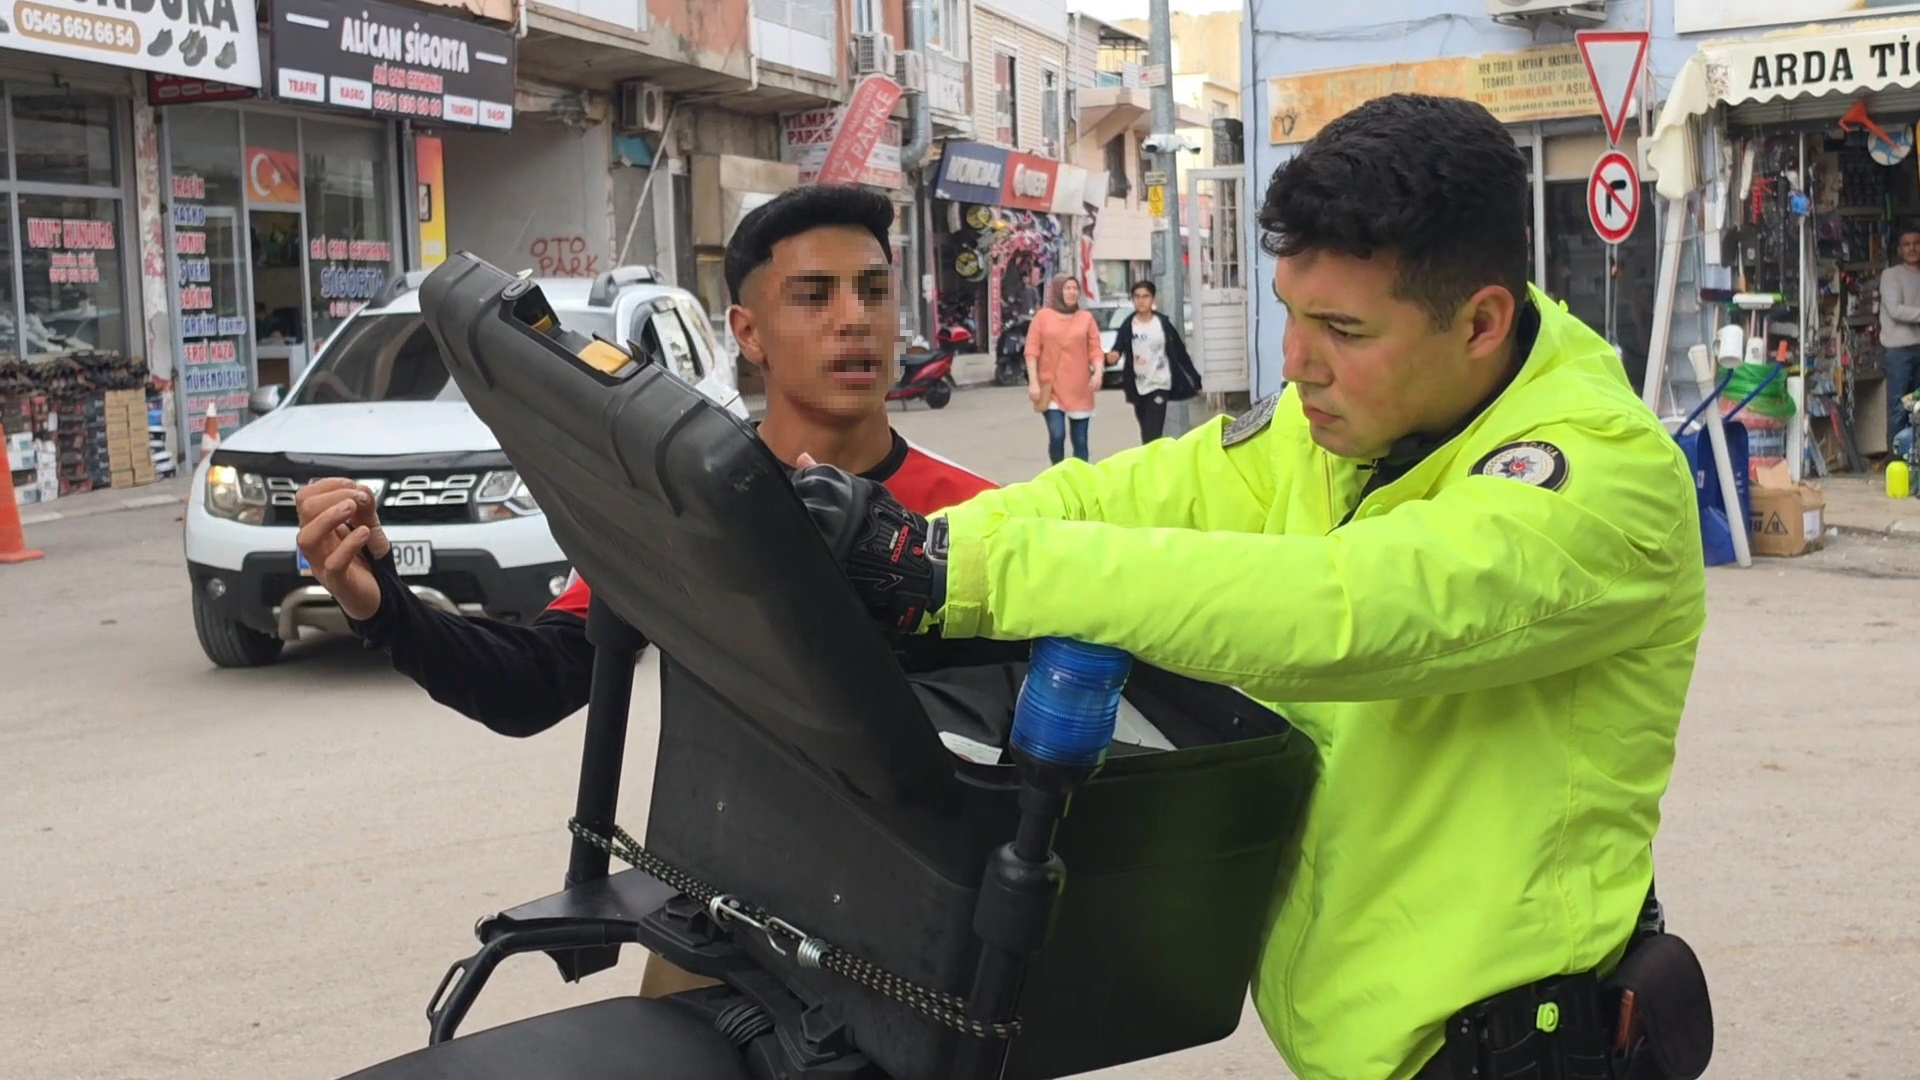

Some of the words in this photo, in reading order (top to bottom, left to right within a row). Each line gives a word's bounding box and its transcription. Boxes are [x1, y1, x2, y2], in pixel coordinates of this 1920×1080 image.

[21, 9, 60, 35] 0545
[64, 16, 93, 41] 662
[94, 20, 115, 44] 66
[116, 25, 134, 48] 54
[341, 10, 402, 61] ALİCAN
[404, 22, 470, 74] SİGORTA
[1749, 48, 1853, 89] ARDA
[1869, 35, 1920, 77] Tİ
[530, 236, 586, 258] OTO
[539, 254, 600, 278] PARK
[393, 545, 425, 567] 901
